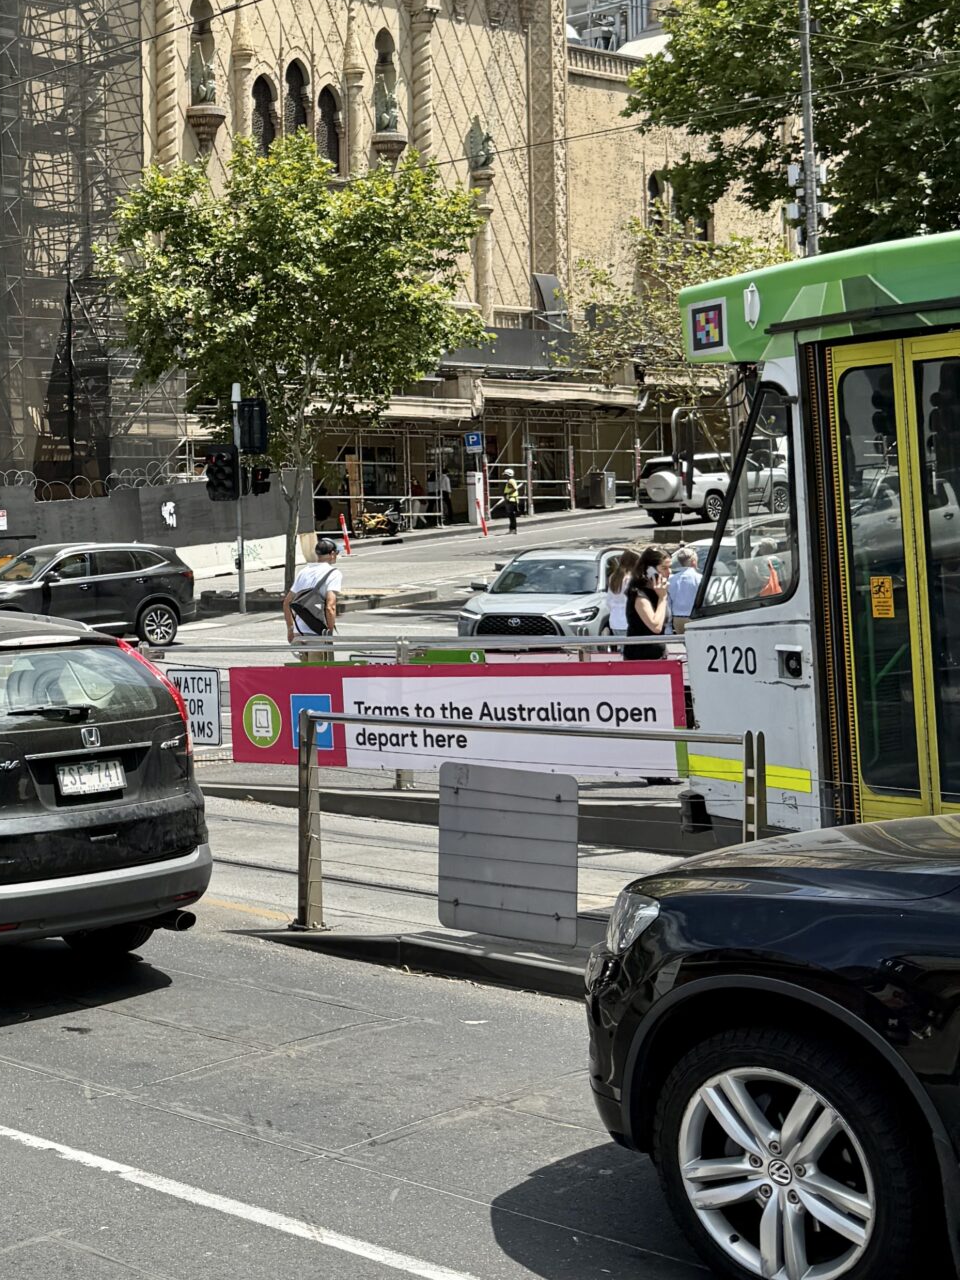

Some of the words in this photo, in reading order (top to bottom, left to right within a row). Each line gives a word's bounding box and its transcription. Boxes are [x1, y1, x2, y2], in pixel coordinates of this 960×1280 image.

[468, 435, 477, 445] P
[706, 644, 757, 675] 2120
[173, 676, 212, 694] WATCH
[353, 701, 410, 717] Trams
[414, 703, 435, 718] to
[440, 701, 473, 720] the
[479, 701, 590, 722] Australian
[596, 701, 657, 727] Open
[190, 721, 213, 738] AMS
[355, 728, 418, 751] depart
[423, 729, 468, 748] here
[58, 766, 86, 787] ZSE
[94, 762, 119, 783] 741
